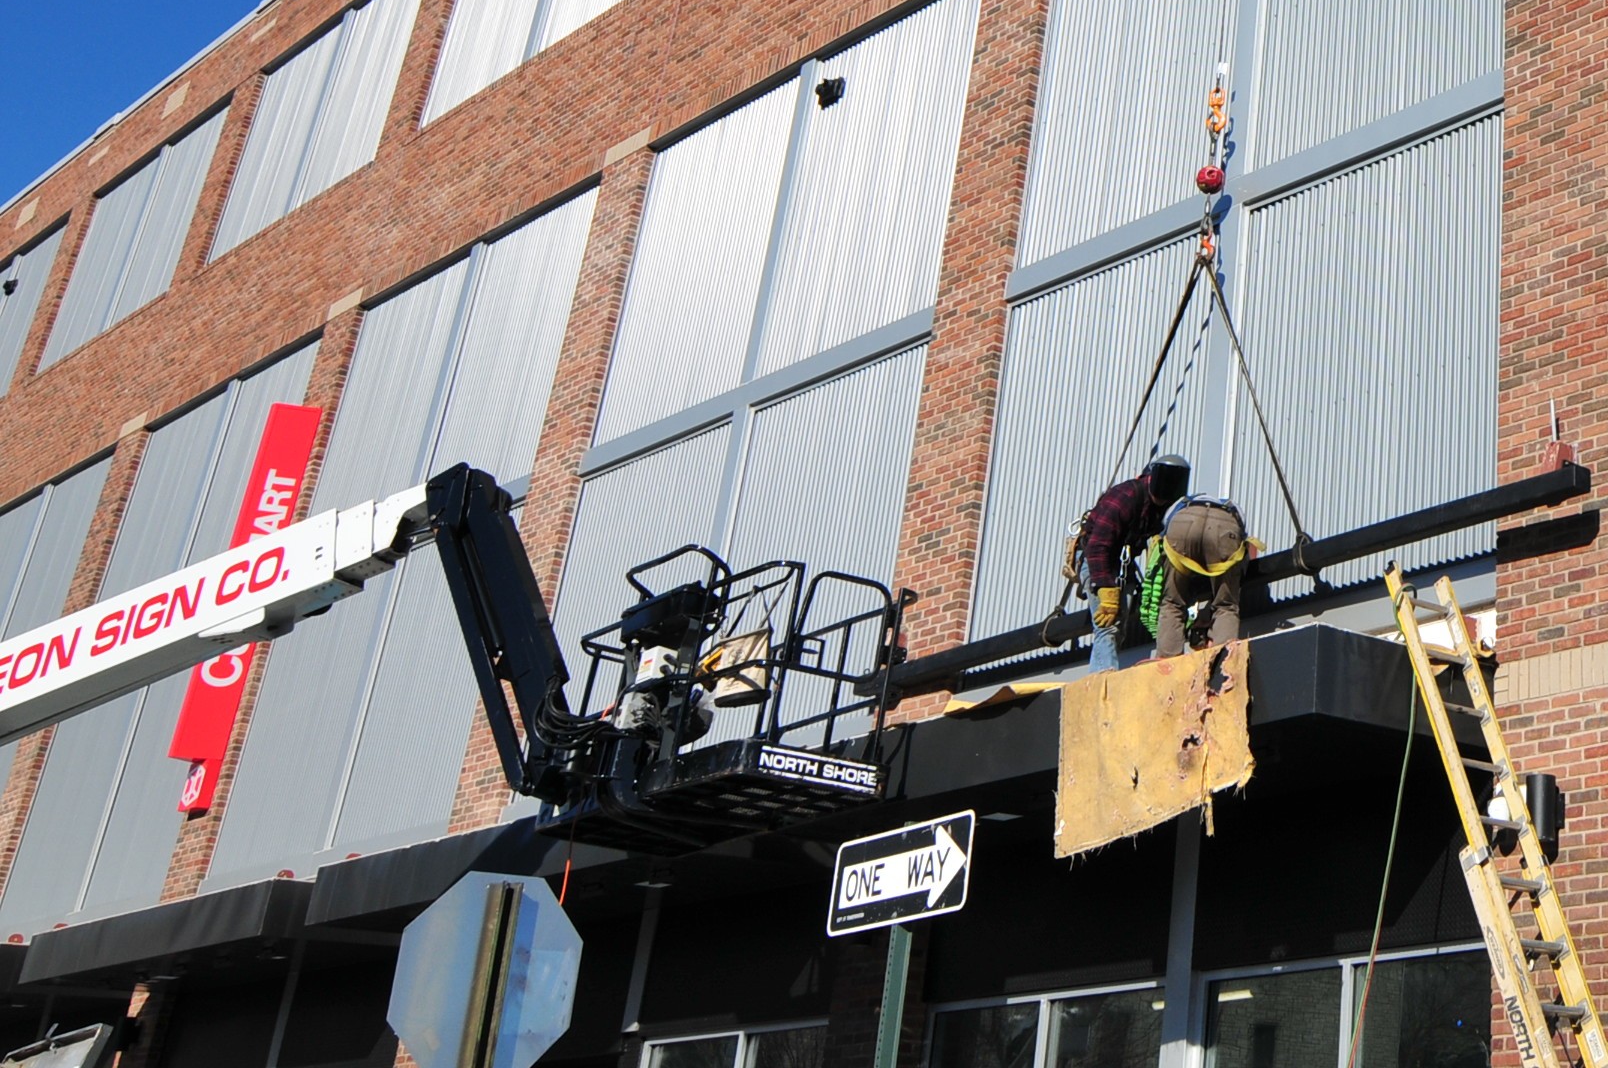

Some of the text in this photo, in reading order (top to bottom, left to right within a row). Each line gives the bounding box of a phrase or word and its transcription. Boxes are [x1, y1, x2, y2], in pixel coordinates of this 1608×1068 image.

[91, 577, 205, 658] SIGN
[214, 546, 290, 607] CO.
[758, 751, 878, 787] NORTH SHORE
[845, 846, 952, 903] ONE WAY
[1504, 995, 1536, 1061] NORTH
